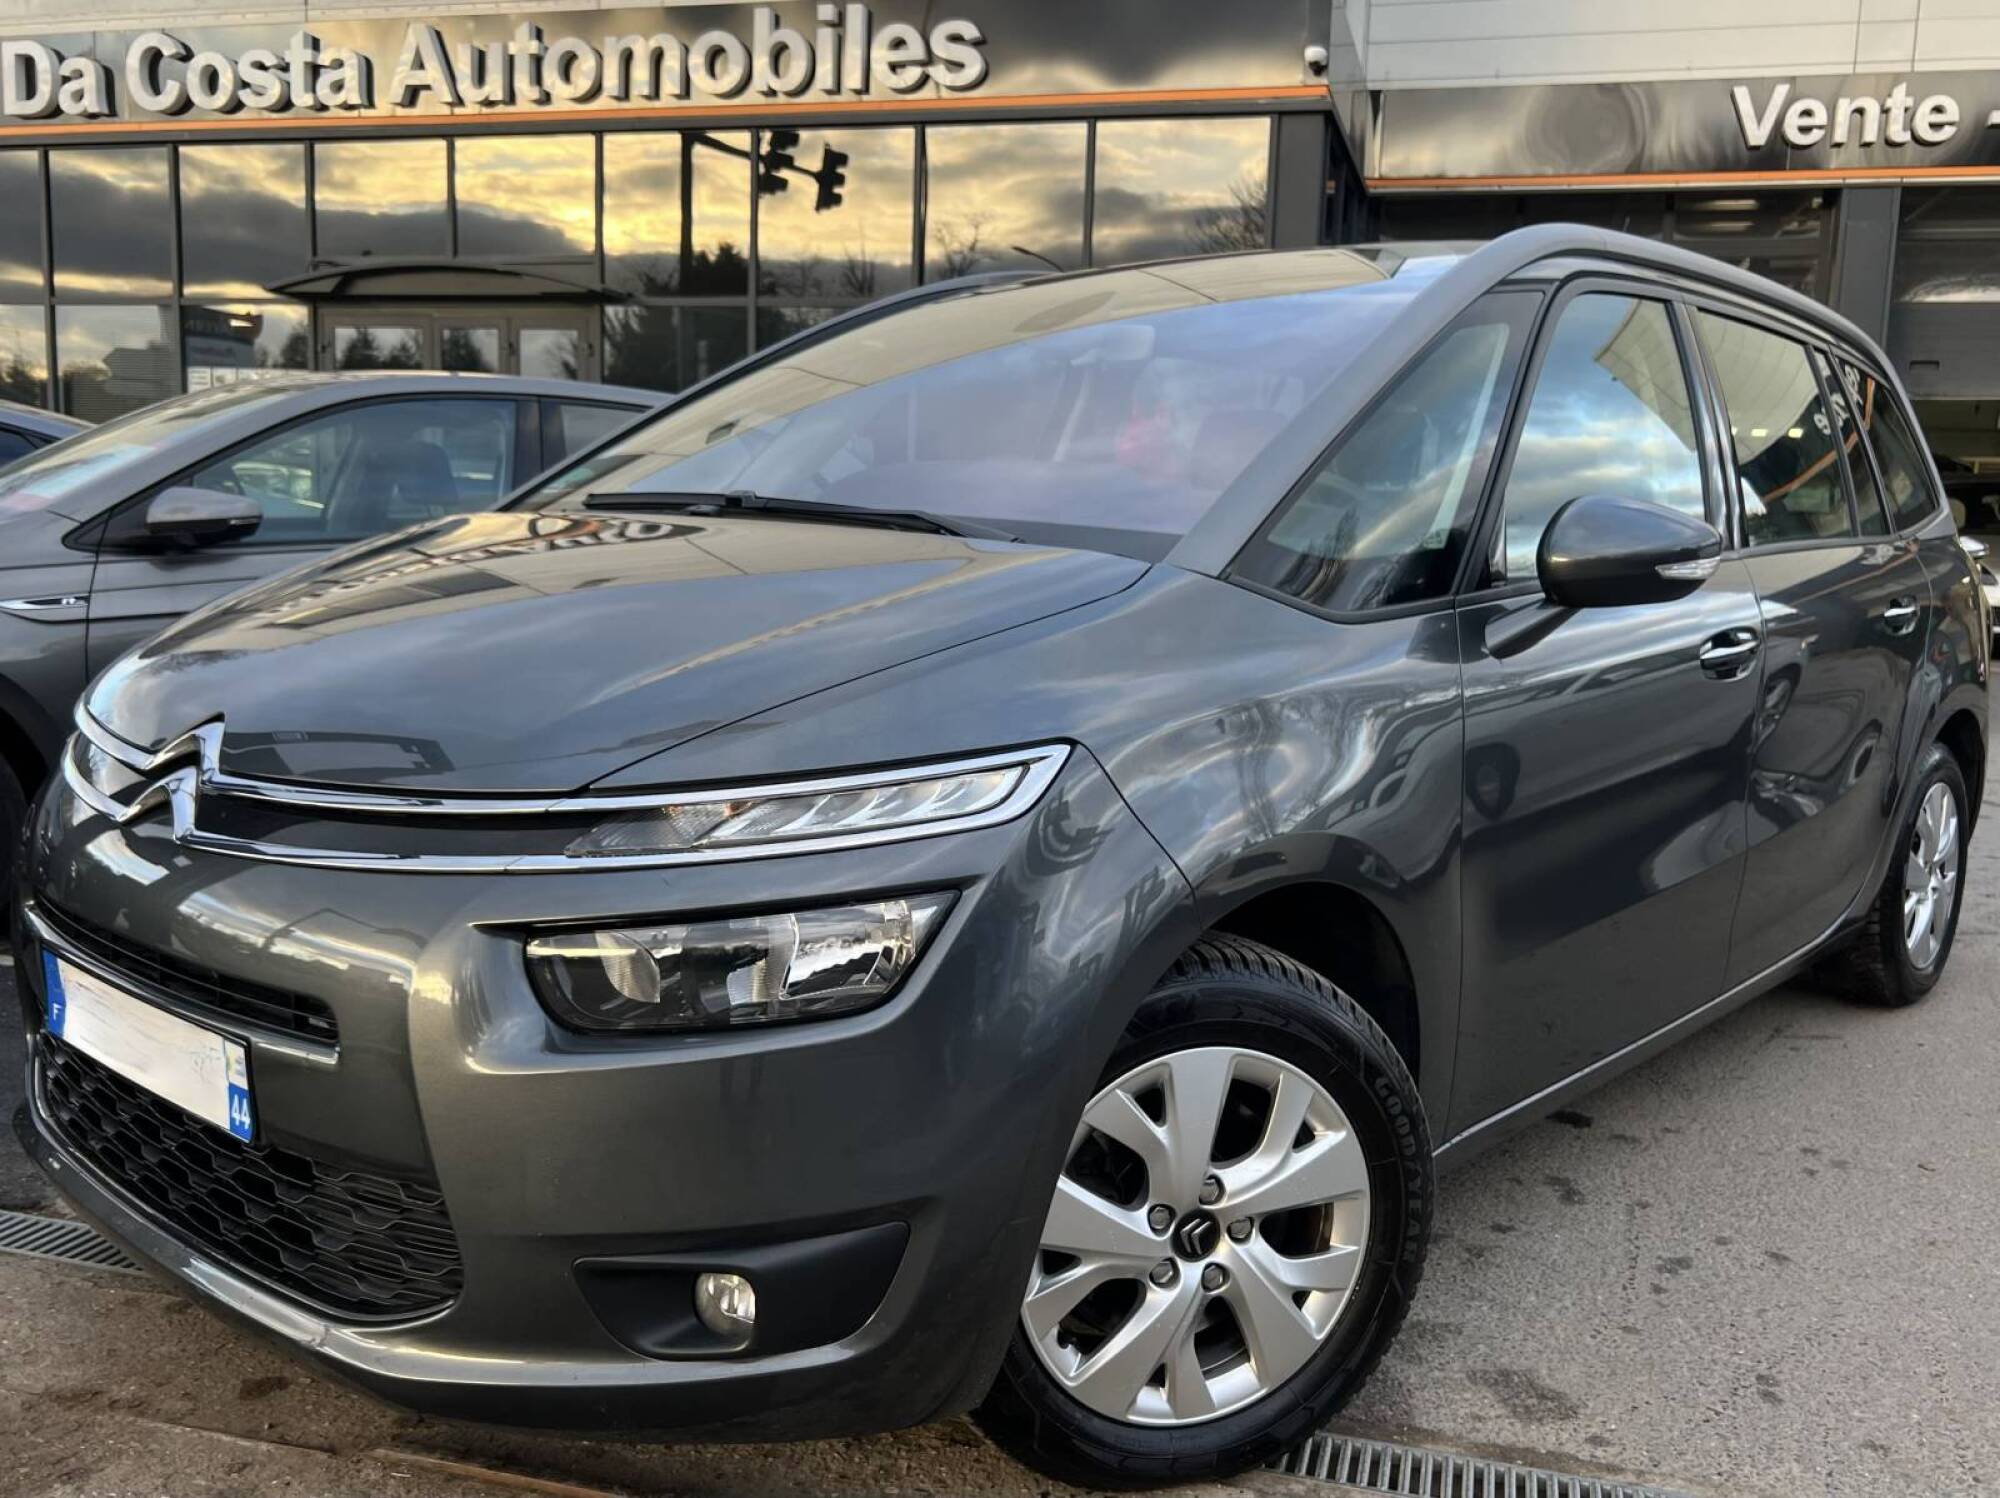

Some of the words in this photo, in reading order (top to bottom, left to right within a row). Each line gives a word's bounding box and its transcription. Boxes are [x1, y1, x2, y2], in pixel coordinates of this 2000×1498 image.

[2, 39, 114, 117] Da
[126, 31, 372, 114] Costa
[390, 4, 986, 106] Automobiles
[1731, 81, 1960, 147] Vente
[52, 1002, 62, 1021] F
[231, 1094, 251, 1129] 44
